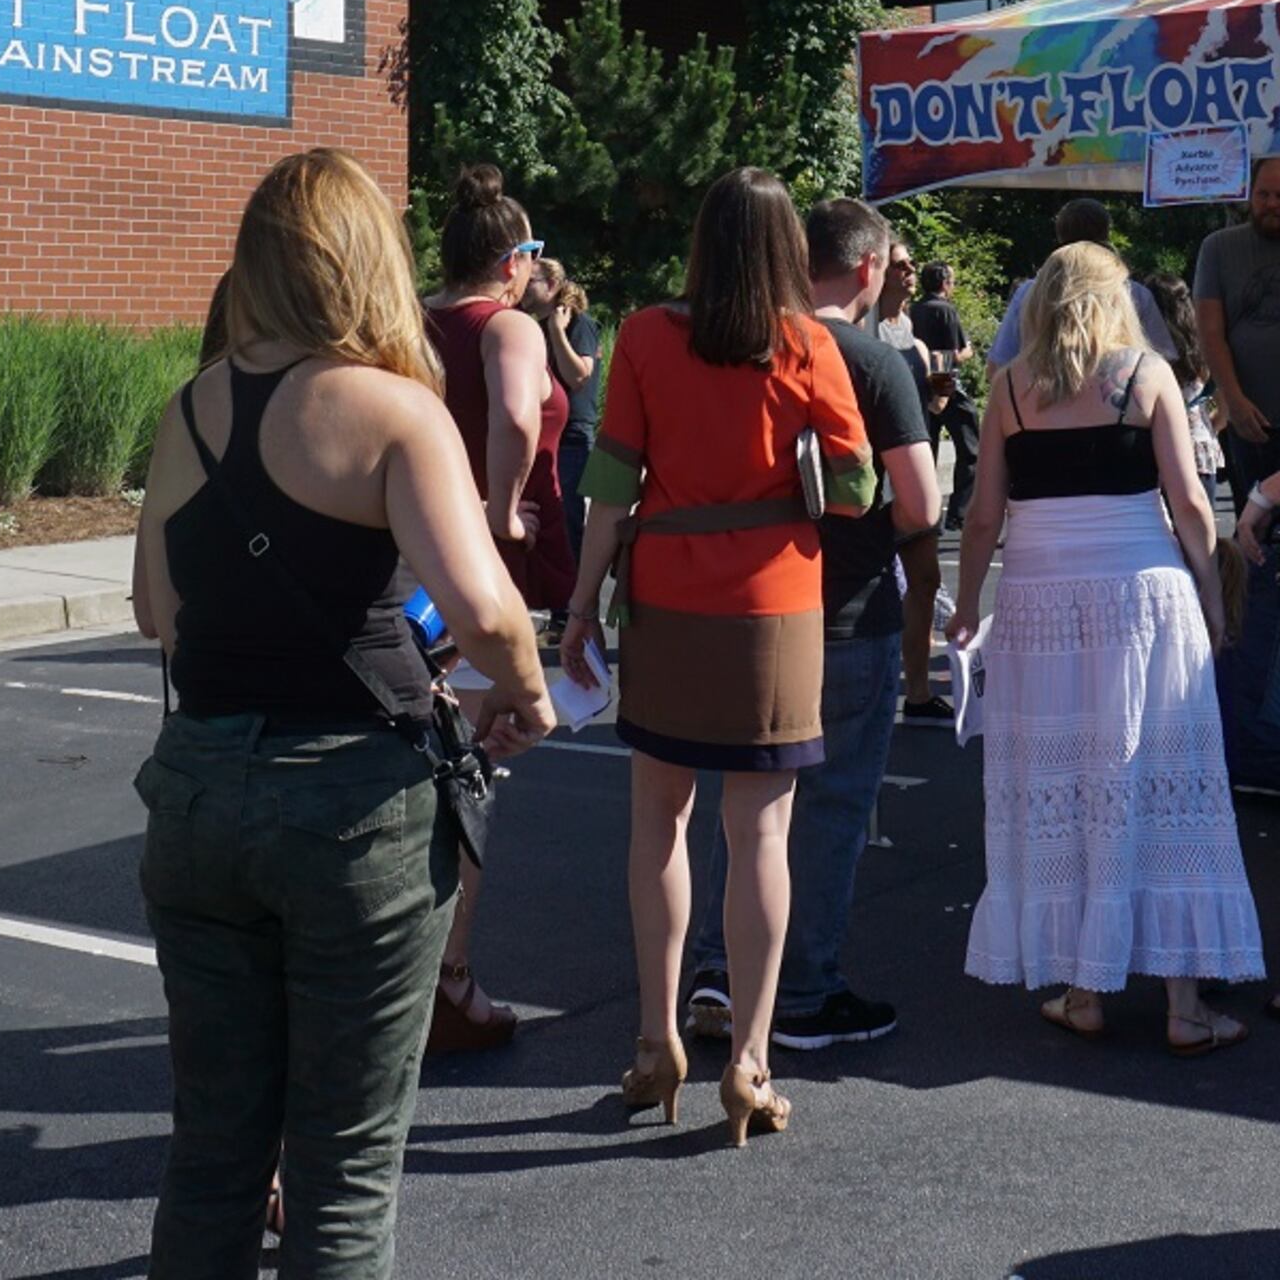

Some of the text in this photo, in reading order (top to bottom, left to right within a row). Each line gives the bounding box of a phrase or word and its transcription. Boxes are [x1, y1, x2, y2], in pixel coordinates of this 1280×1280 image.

[872, 75, 1050, 145] DON'T
[1063, 57, 1273, 133] FLOAT
[1175, 162, 1219, 173] Advance
